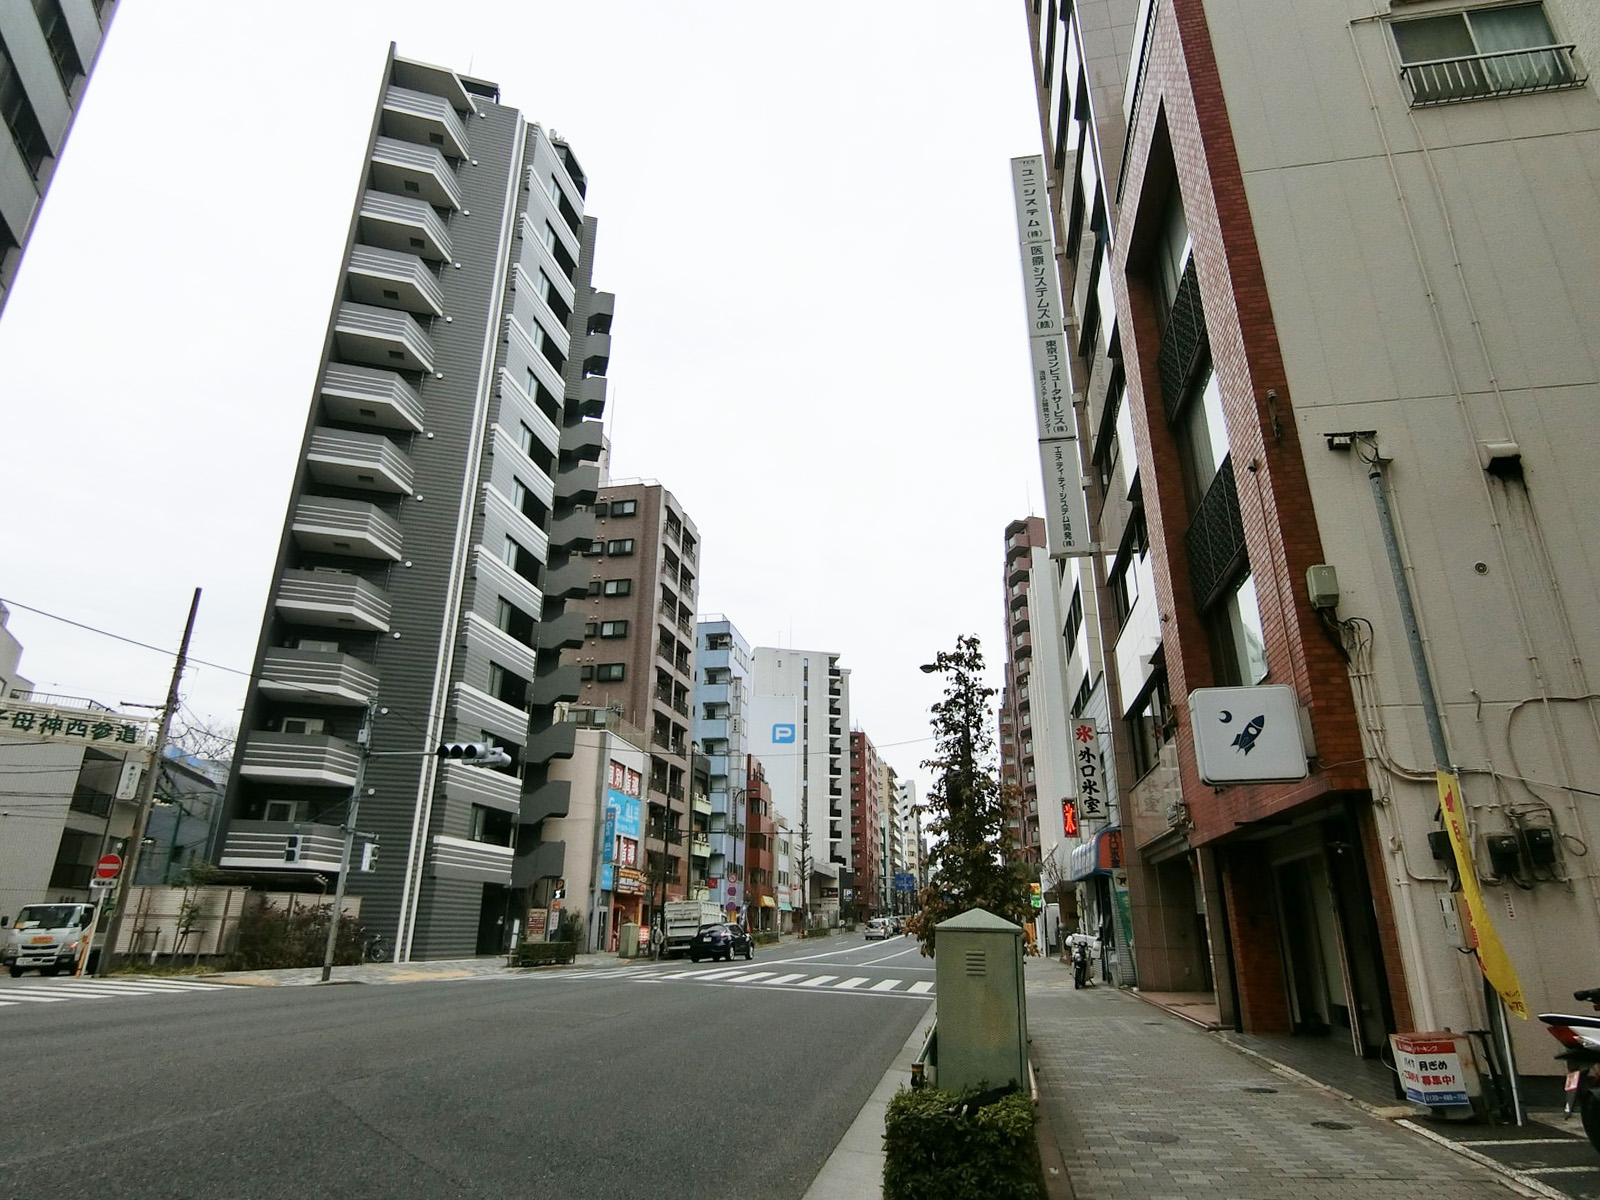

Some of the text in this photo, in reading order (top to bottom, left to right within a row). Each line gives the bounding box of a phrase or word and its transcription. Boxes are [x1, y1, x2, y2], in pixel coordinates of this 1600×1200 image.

[1079, 747, 1101, 814] 外口氷室
[1419, 1060, 1448, 1071] 月ぎめ
